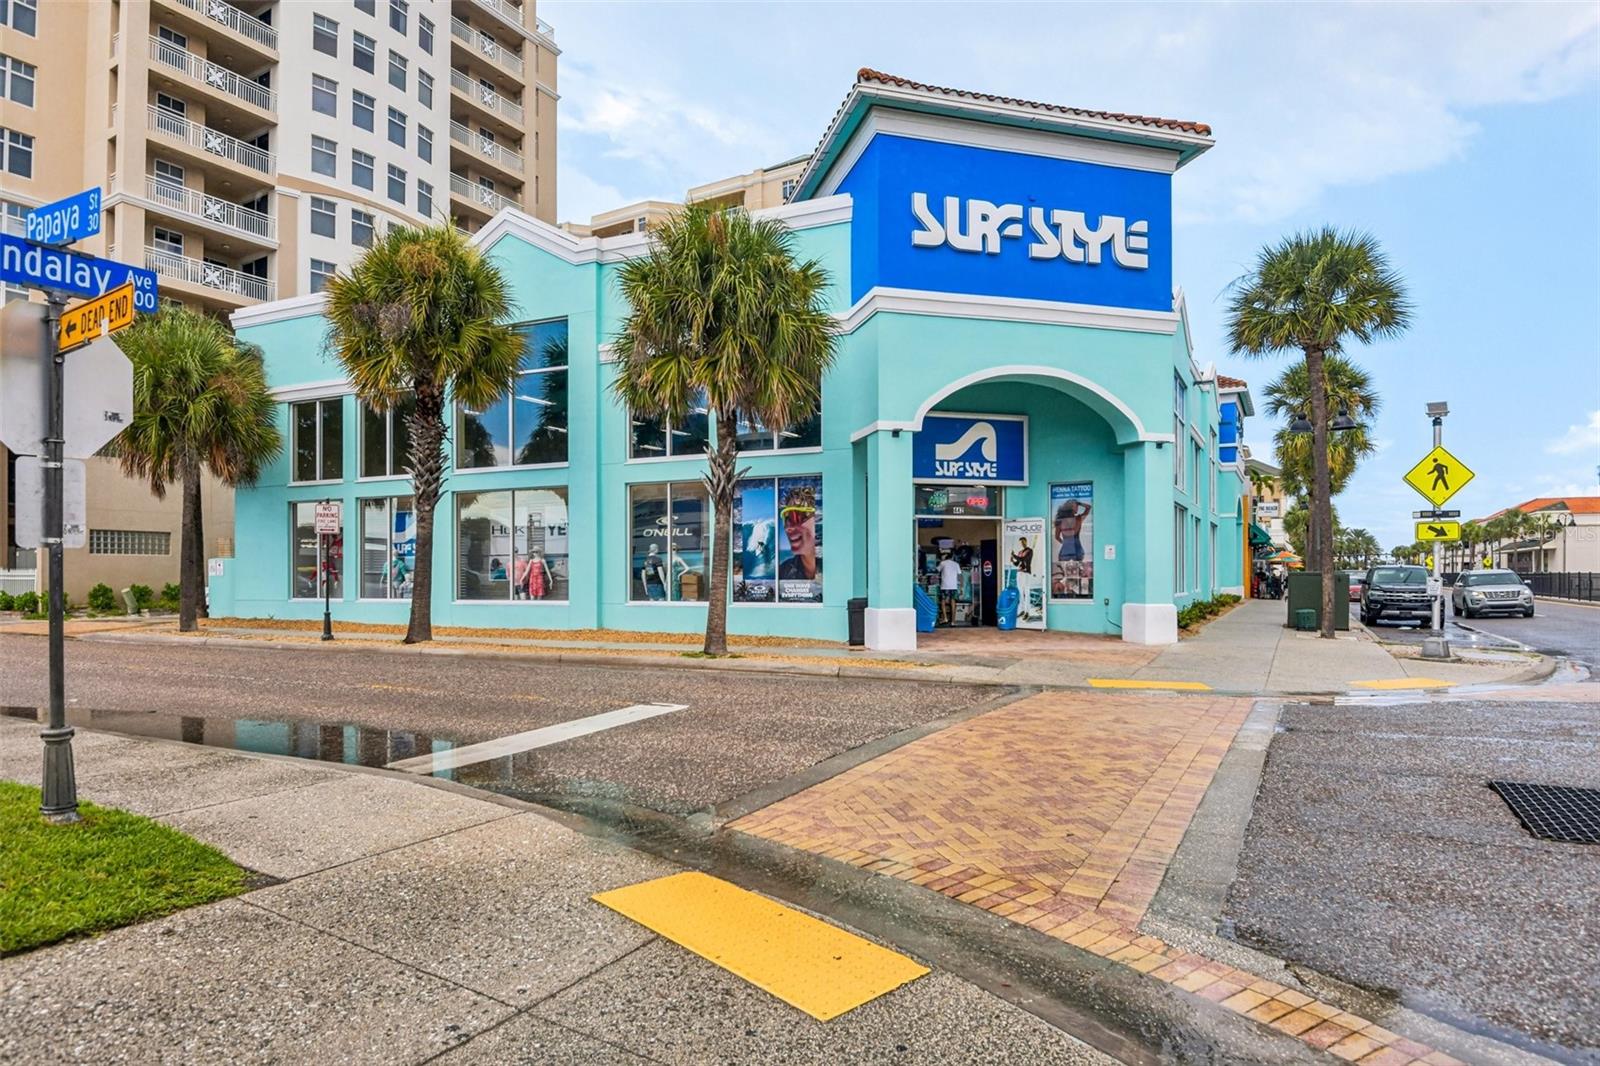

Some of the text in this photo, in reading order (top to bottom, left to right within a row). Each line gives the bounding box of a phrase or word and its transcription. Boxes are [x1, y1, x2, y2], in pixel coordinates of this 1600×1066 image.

[27, 192, 98, 243] Papaya St
[87, 213, 99, 232] 30
[911, 191, 1149, 270] SURF STYLE
[126, 270, 152, 290] Ave
[80, 295, 129, 335] DEAD END
[935, 460, 997, 478] SURF STYLE
